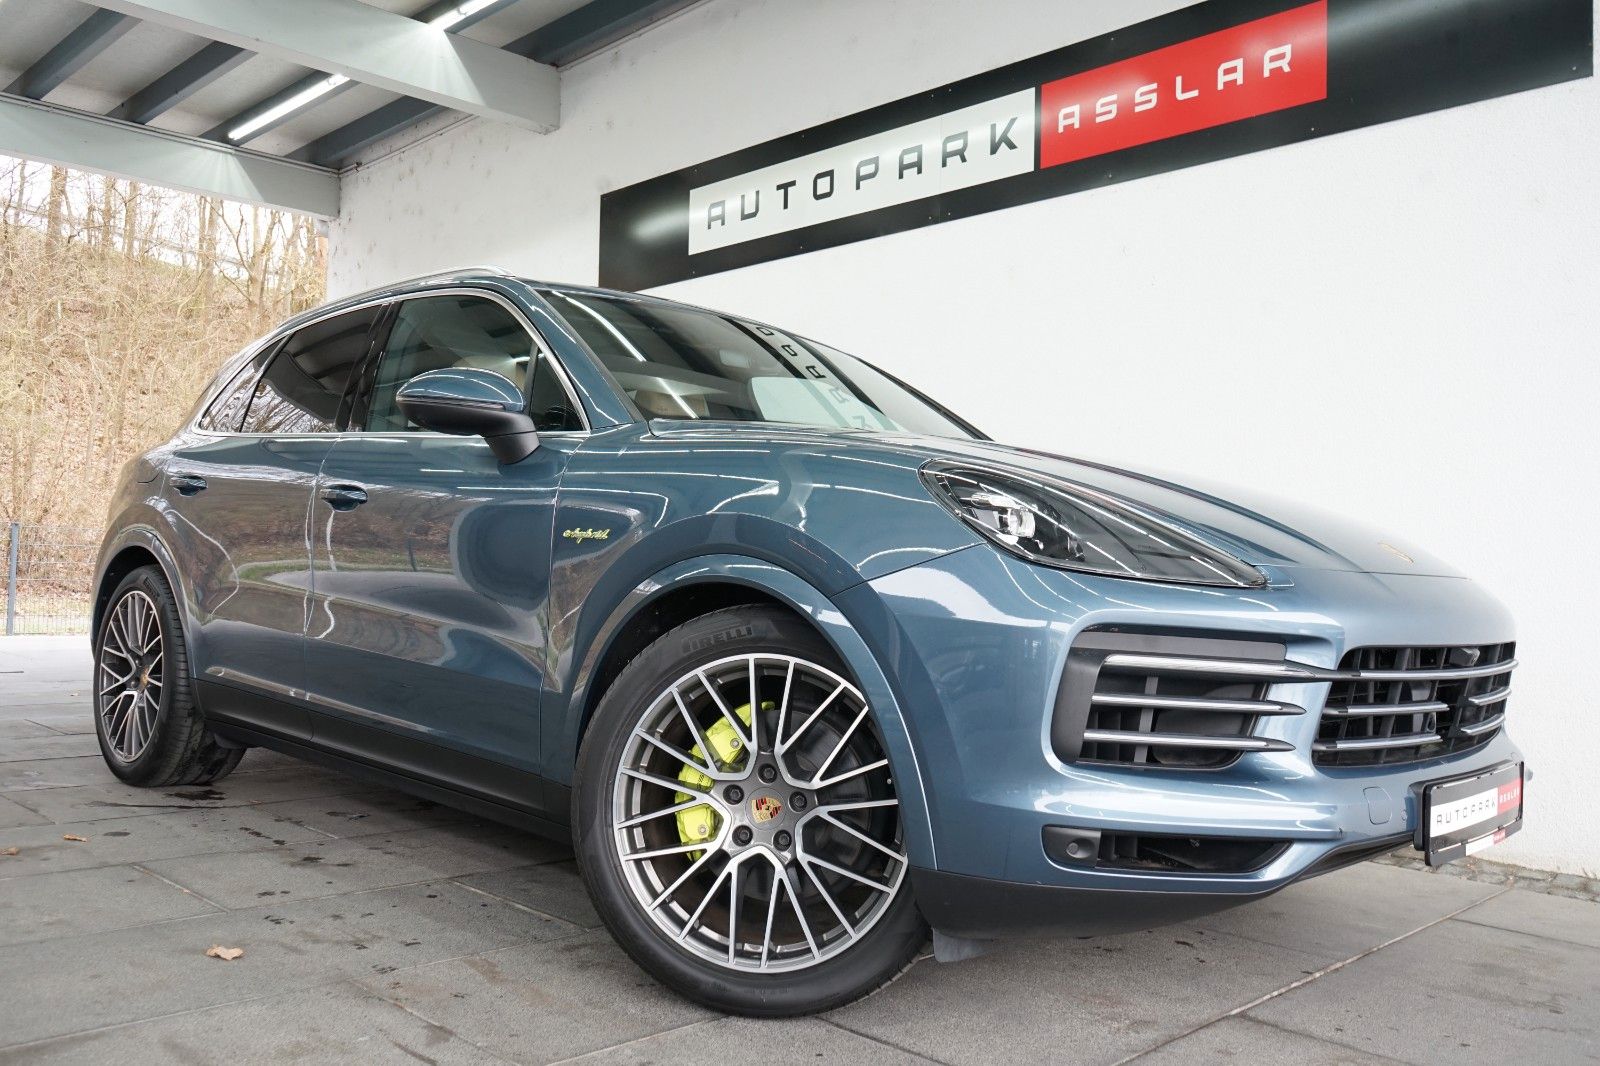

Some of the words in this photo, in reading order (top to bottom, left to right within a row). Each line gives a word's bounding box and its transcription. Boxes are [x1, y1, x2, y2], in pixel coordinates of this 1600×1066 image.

[706, 116, 1019, 230] AUTOPARK
[1057, 43, 1294, 134] ASSLAR
[681, 624, 753, 654] PIRELLI
[1436, 797, 1496, 825] AUTOPARK
